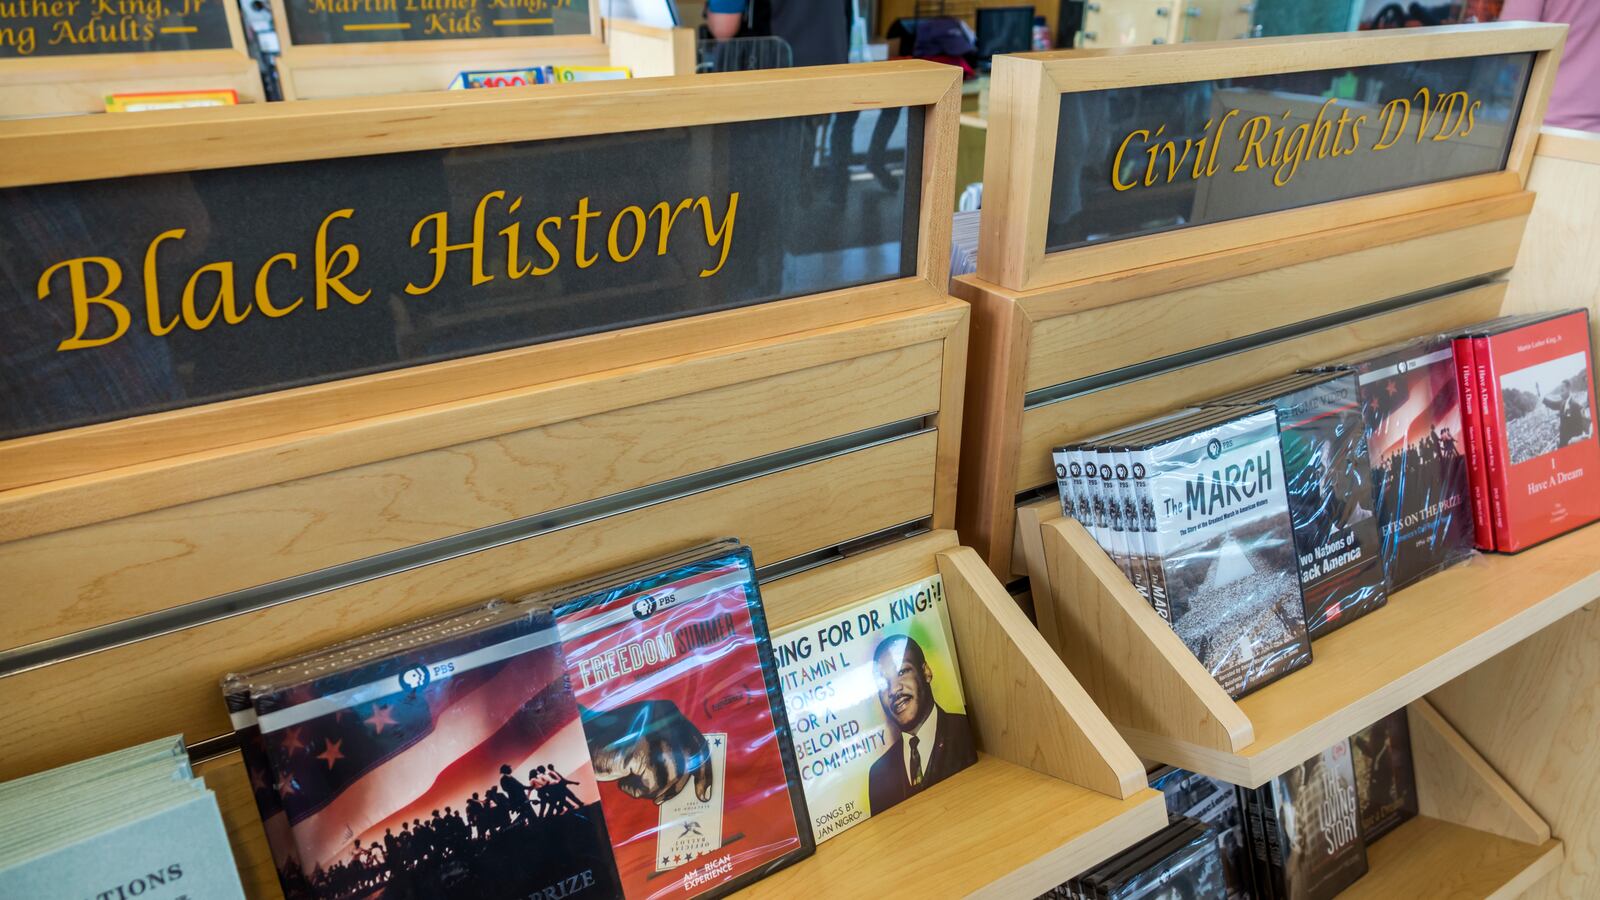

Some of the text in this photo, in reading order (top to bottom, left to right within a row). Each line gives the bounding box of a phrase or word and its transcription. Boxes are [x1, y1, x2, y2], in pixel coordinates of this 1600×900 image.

[49, 15, 155, 45] Adults
[423, 12, 482, 35] Kids
[1111, 87, 1481, 192] Civil Rights DVDs
[37, 190, 740, 351] Black History
[1551, 457, 1556, 470] I
[1163, 450, 1272, 521] The MARCH
[1527, 468, 1584, 496] Have A Dream
[1404, 511, 1419, 527] ON
[1419, 503, 1438, 520] THE
[1314, 538, 1345, 559] Nations
[1346, 530, 1355, 545] of
[1301, 563, 1322, 584] ack
[1323, 546, 1362, 574] America
[658, 594, 676, 607] PBS
[818, 619, 854, 652] FOR
[857, 609, 885, 637] DR.
[889, 588, 933, 624] KING!
[578, 612, 735, 690] FREEDOM SUMMER
[840, 652, 850, 668] L
[433, 662, 455, 677] PBS
[795, 719, 860, 760] BELOVED
[801, 729, 886, 781] COMMUNITY
[815, 800, 855, 827] SONGS BY
[1320, 785, 1357, 833] LOVING
[817, 824, 834, 840] JAN
[1325, 813, 1358, 855] STORY
[96, 863, 183, 900] TIONS
[683, 853, 732, 883] AMRICAN
[684, 861, 734, 892] EXPERIENCE
